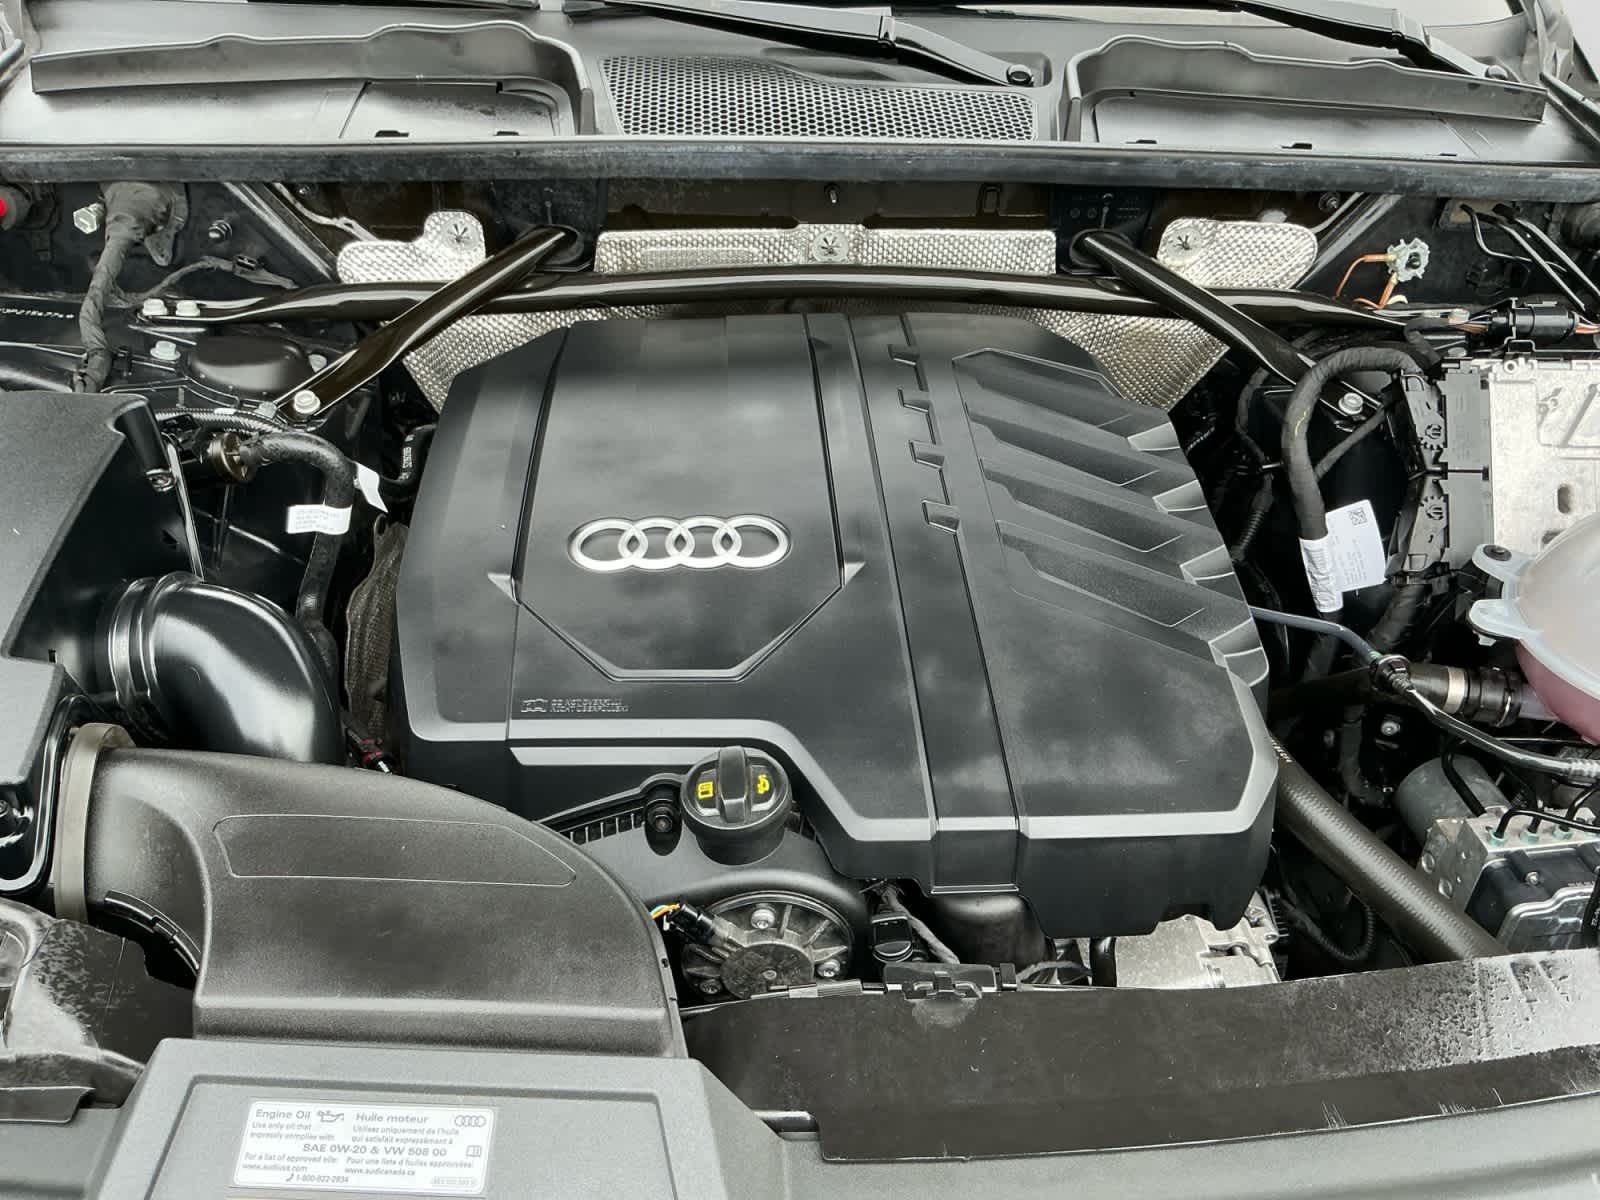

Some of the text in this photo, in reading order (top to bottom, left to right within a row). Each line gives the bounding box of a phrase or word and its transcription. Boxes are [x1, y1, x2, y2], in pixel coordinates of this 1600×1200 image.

[255, 1108, 311, 1120] Engine Oil
[355, 1111, 430, 1124] Huile moteur
[252, 1121, 312, 1131] Use only oil that
[352, 1125, 380, 1133] Utilisez
[380, 1126, 425, 1136] uniquement
[425, 1127, 436, 1135] de
[351, 1135, 364, 1144] qui
[303, 1143, 447, 1157] SAE 0W-20 & VW 508 00
[244, 1152, 257, 1161] For
[264, 1153, 276, 1161] list
[276, 1153, 286, 1161] of
[286, 1154, 322, 1164] approved
[346, 1157, 365, 1166] Pour
[380, 1157, 397, 1166] liste
